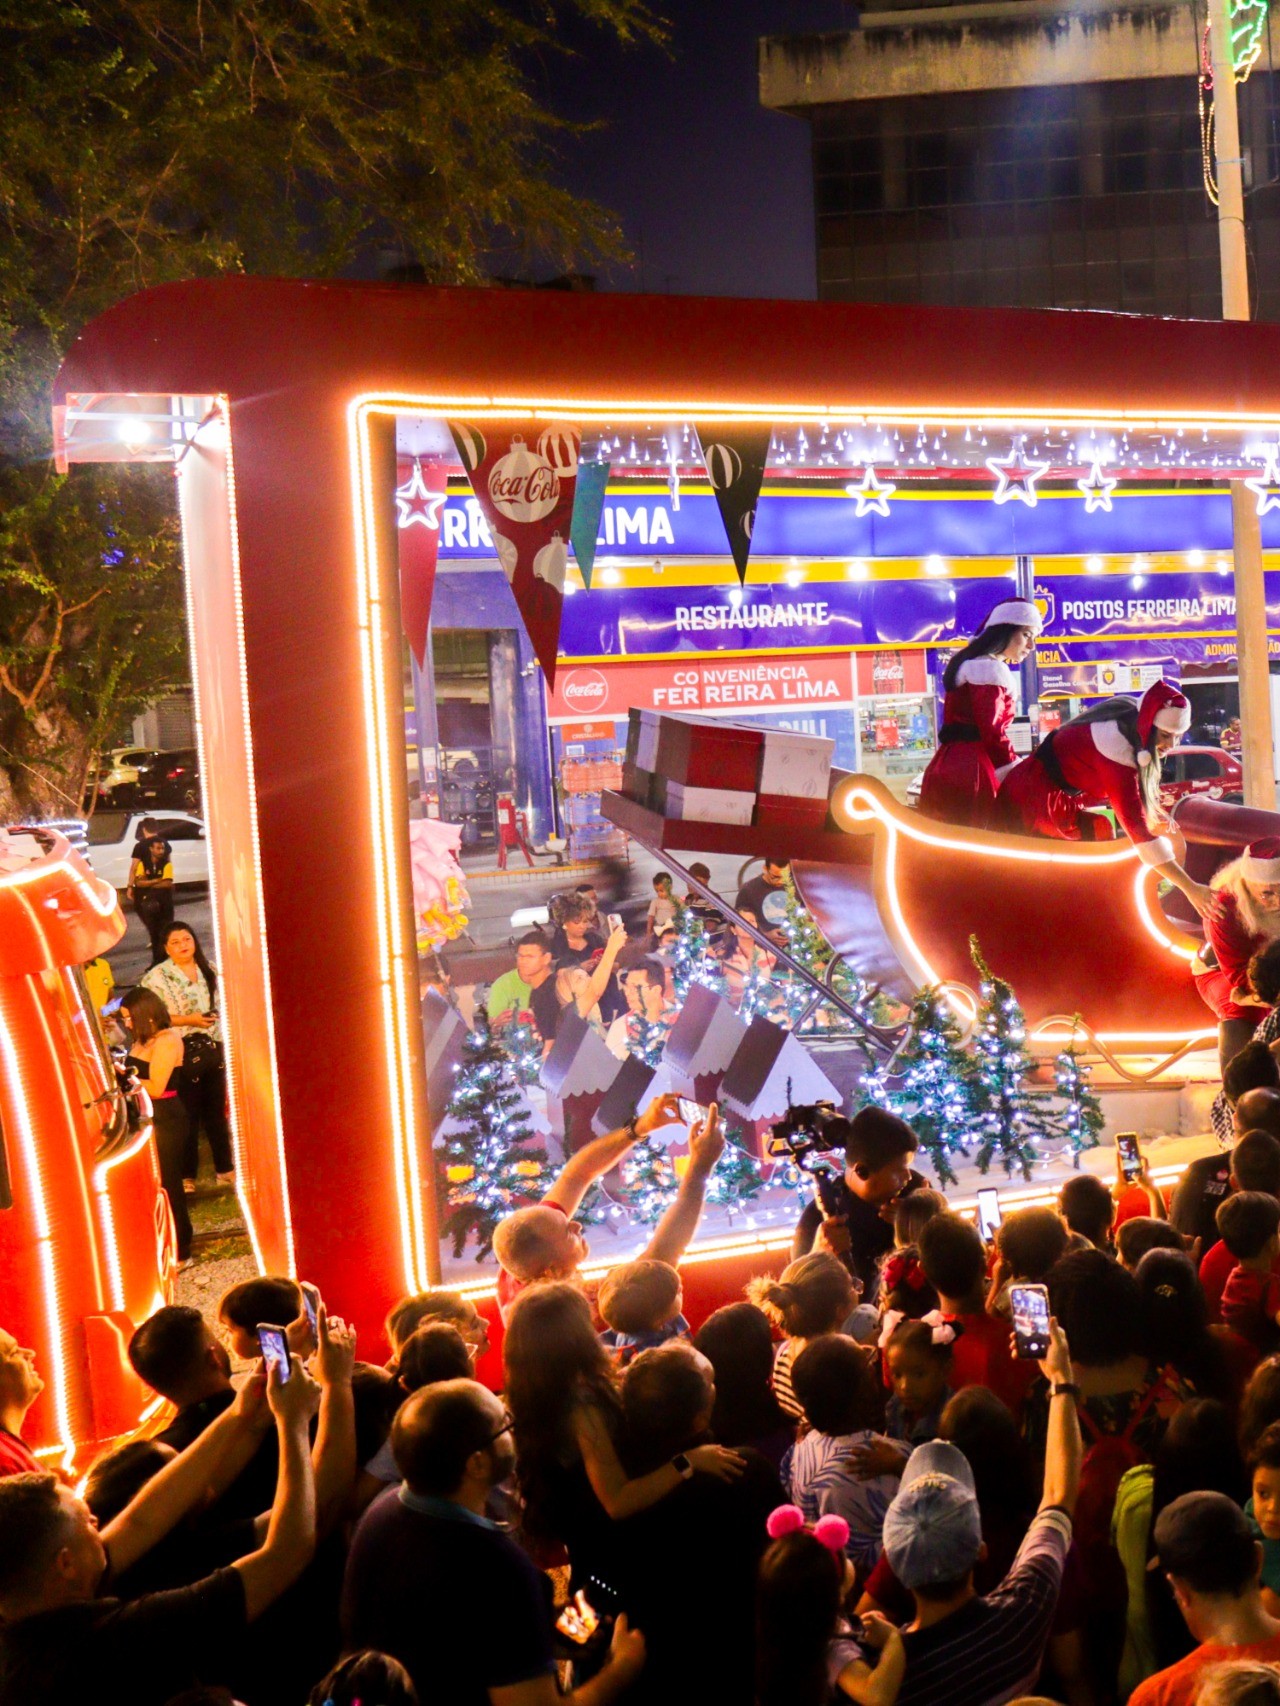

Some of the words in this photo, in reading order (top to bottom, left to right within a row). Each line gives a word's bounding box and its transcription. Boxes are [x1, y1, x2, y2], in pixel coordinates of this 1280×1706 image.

[675, 602, 829, 631] RESTAURANTE
[1062, 601, 1124, 620] POSTOS
[1128, 598, 1200, 618] FERREIRA
[873, 665, 904, 680] Coca-Cola
[565, 682, 605, 697] Coca-Cola
[783, 680, 840, 699] LIMA
